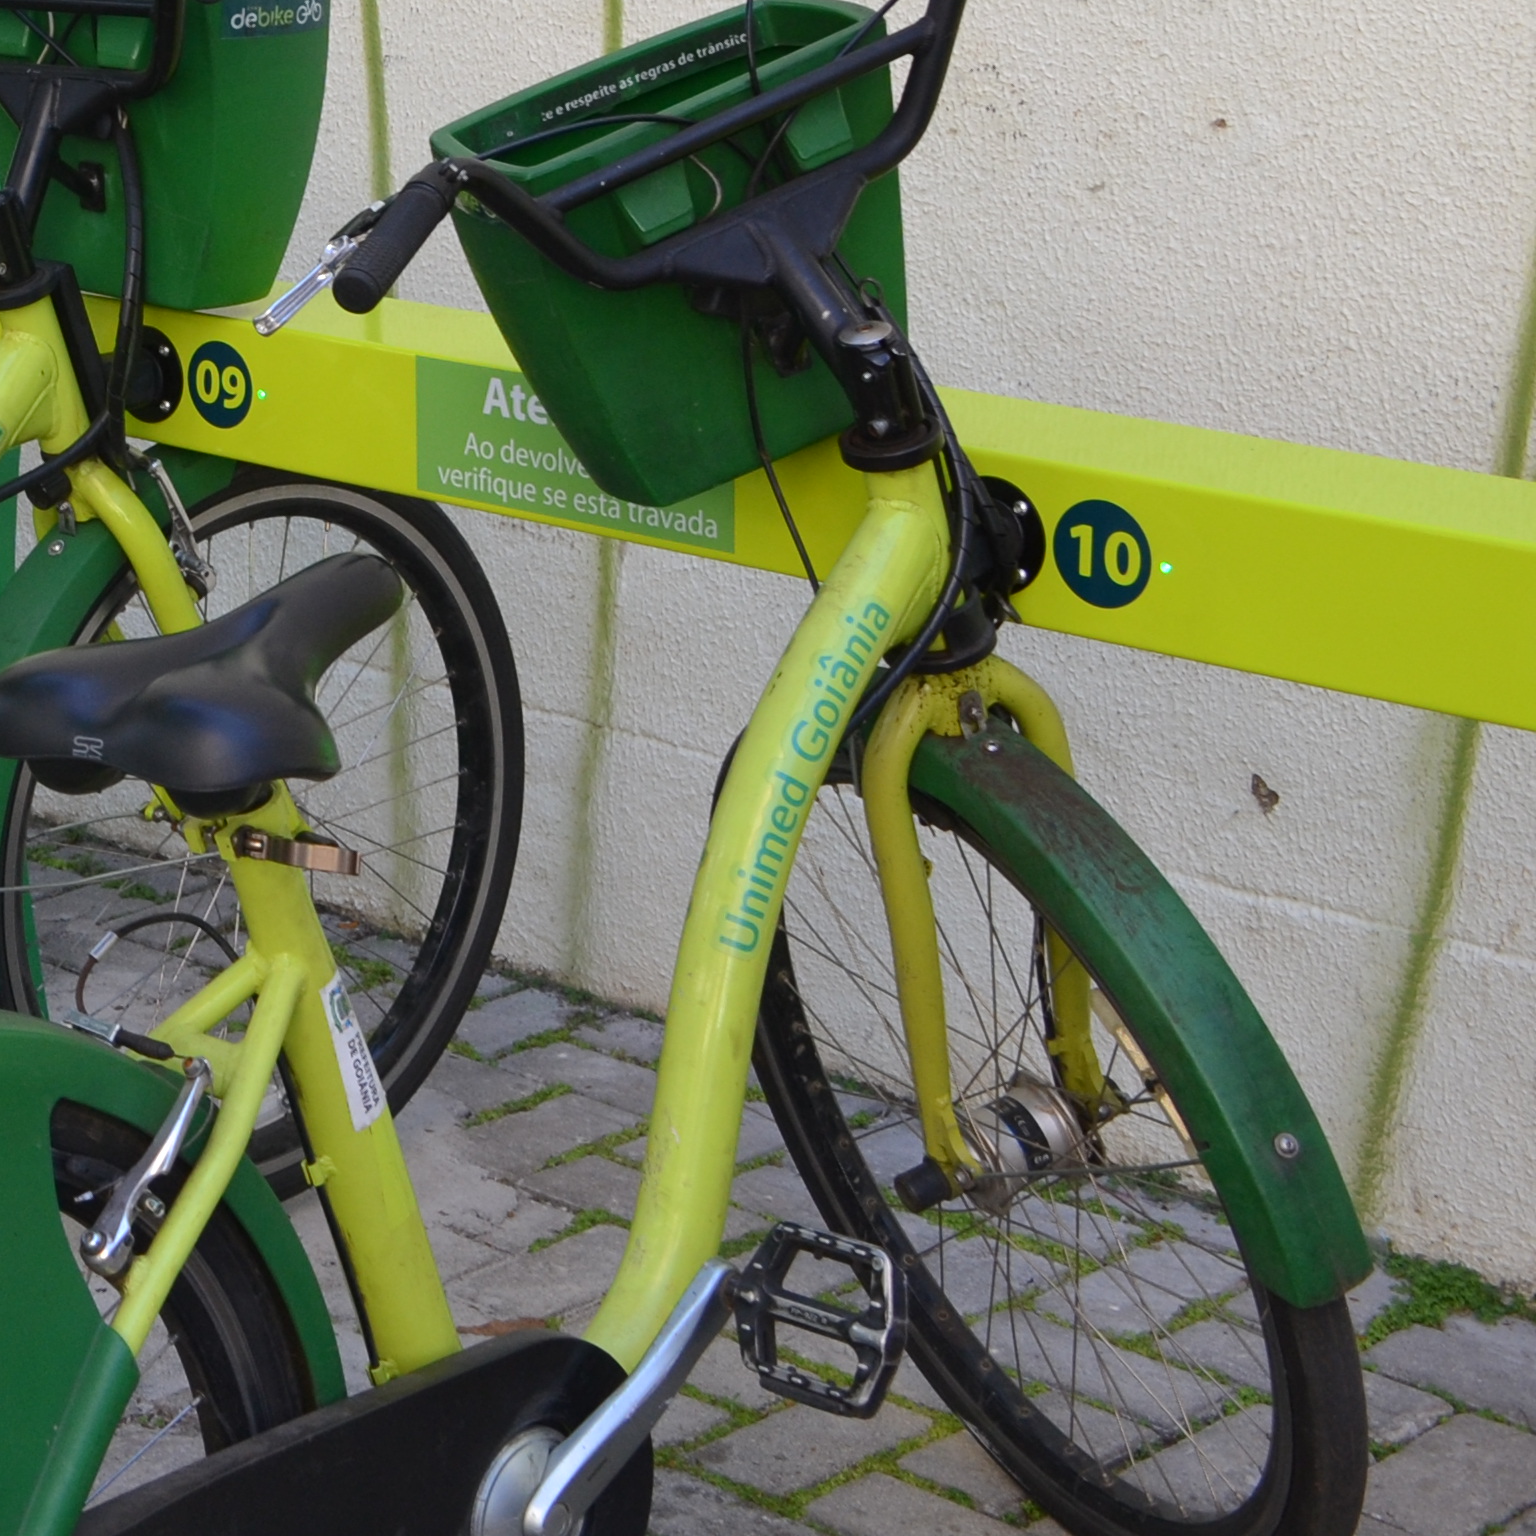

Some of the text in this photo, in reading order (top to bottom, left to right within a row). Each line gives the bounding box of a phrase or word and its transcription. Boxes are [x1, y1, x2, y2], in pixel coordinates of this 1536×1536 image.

[230, 5, 294, 29] debike
[565, 82, 617, 113] respeite
[619, 75, 633, 90] as
[635, 59, 676, 83] regras
[678, 50, 694, 66] de
[195, 359, 246, 409] 09
[464, 432, 590, 478] Ao devolve
[438, 465, 718, 539] verifique se está travada
[1070, 524, 1142, 586] 10
[719, 601, 890, 953] Unimed Goiânia
[348, 1038, 373, 1114] DE GOIÂNIA
[355, 1032, 380, 1107] PREFEITURA
